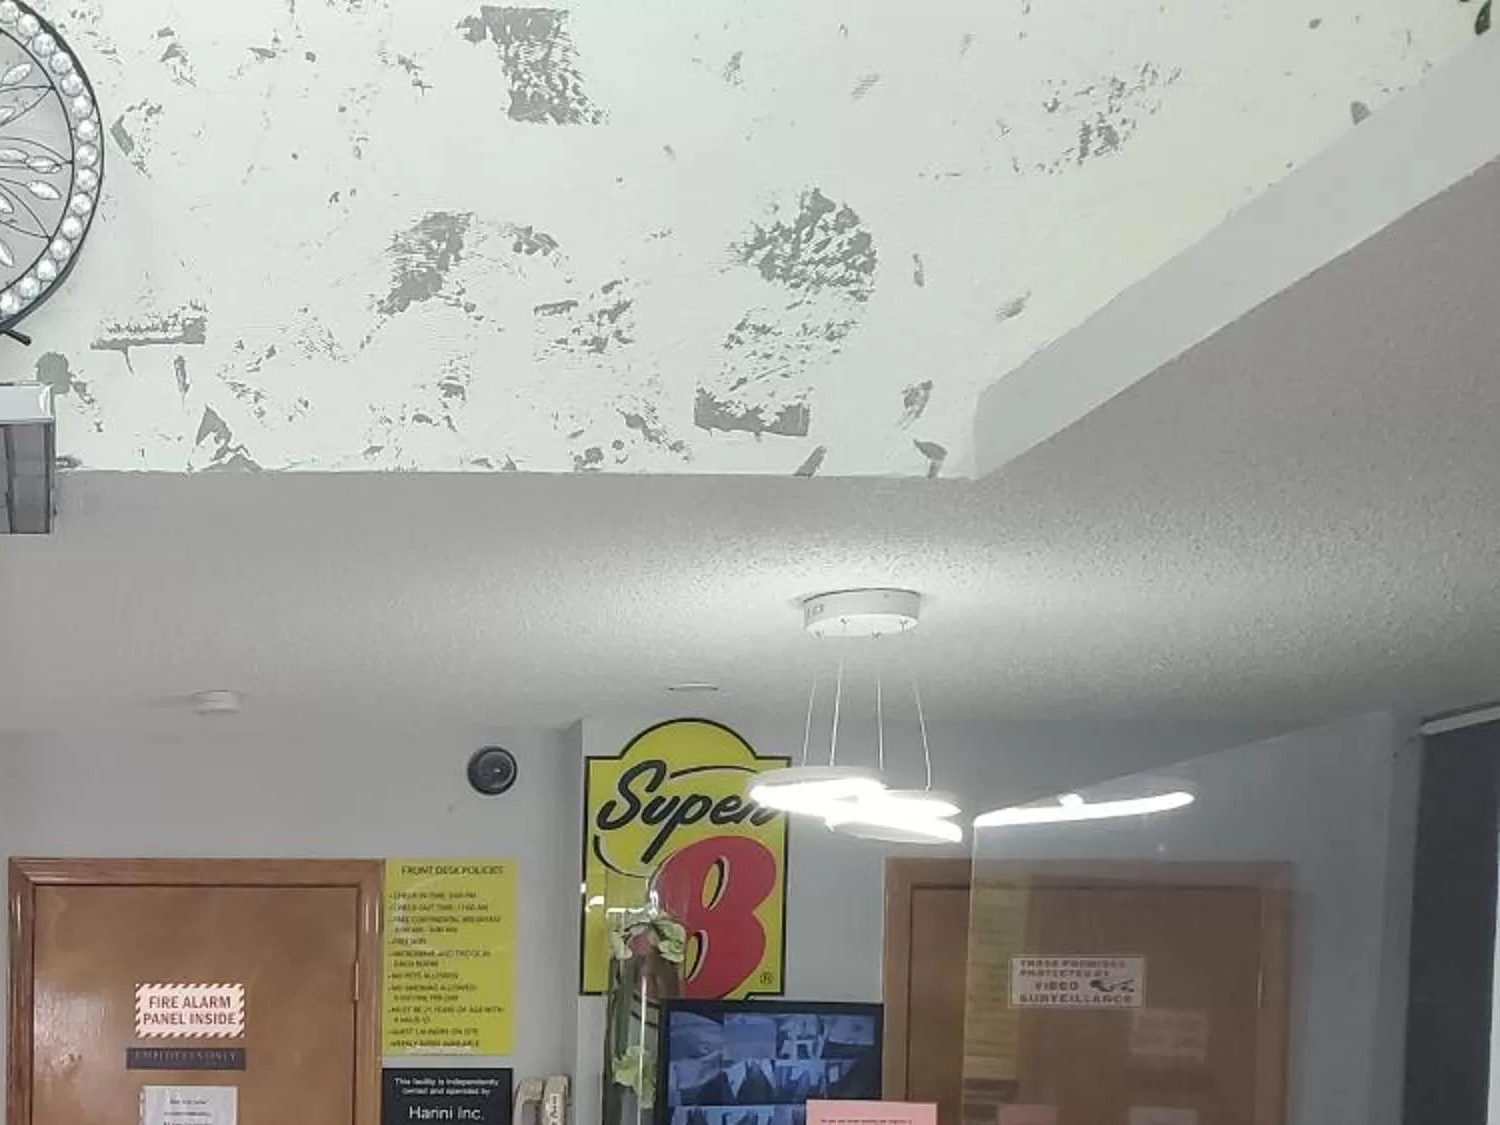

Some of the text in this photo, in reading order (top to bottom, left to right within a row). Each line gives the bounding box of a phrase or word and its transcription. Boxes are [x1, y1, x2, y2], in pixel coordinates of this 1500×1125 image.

[596, 759, 781, 865] Super
[401, 865, 505, 875] FRONT DESK POLICIES
[650, 835, 776, 1000] 8
[1034, 981, 1079, 991] VIDEO
[149, 995, 232, 1009] FIRE ALARM
[1019, 993, 1132, 1004] SURVEILLANCE
[143, 1011, 238, 1025] PANEL INSIDE
[394, 1077, 411, 1086] This
[446, 1078, 500, 1088] independently
[429, 1088, 445, 1096] and
[446, 1088, 479, 1097] operated
[480, 1088, 492, 1098] by
[457, 1105, 485, 1121] Inc.
